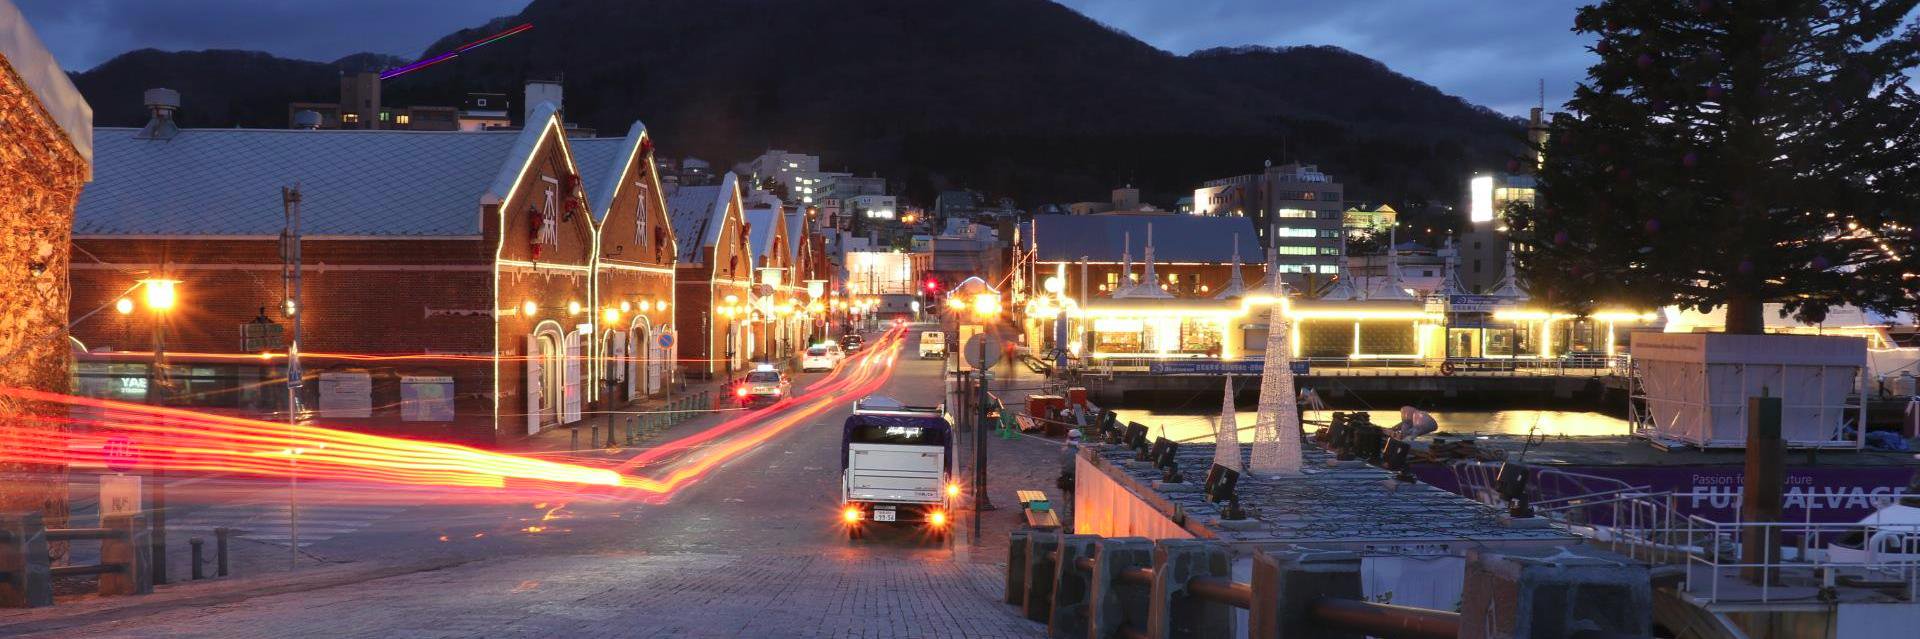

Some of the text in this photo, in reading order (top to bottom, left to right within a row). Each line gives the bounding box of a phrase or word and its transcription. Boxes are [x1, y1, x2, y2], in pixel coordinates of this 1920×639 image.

[1692, 473, 1733, 485] Passion
[1783, 475, 1812, 485] uture
[1783, 486, 1908, 508] ALVAGE
